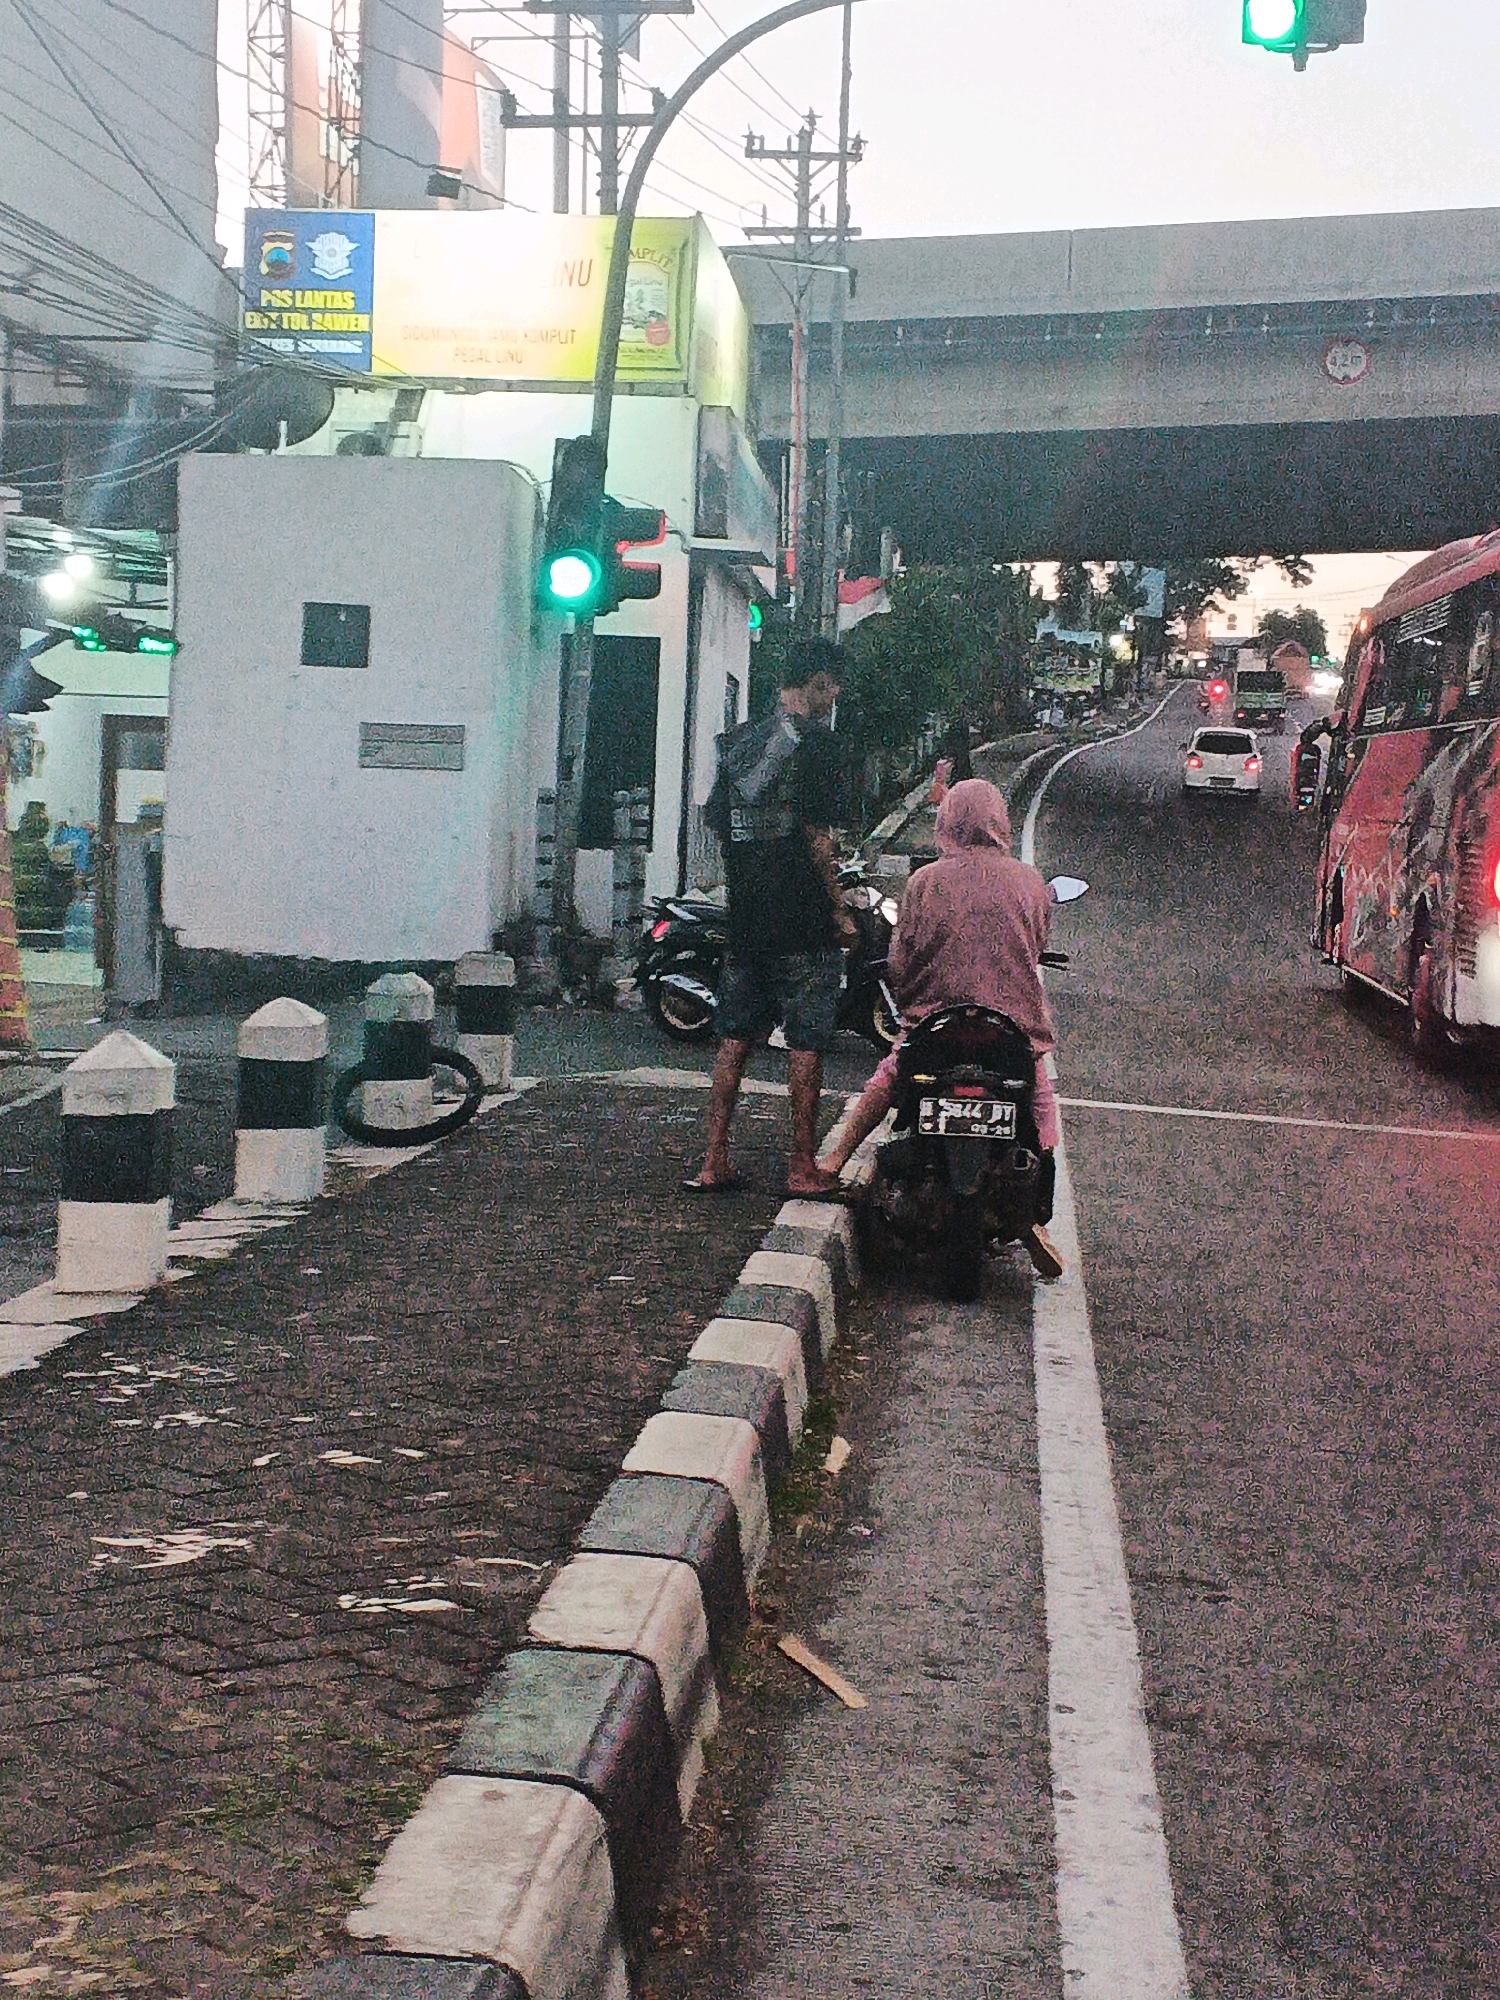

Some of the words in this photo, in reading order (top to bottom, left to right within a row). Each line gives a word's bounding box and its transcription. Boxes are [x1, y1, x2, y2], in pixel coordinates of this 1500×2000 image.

[295, 290, 355, 309] LANTAS
[312, 313, 370, 332] BAWEN
[452, 347, 491, 363] PEGAL
[495, 348, 525, 364] LINU
